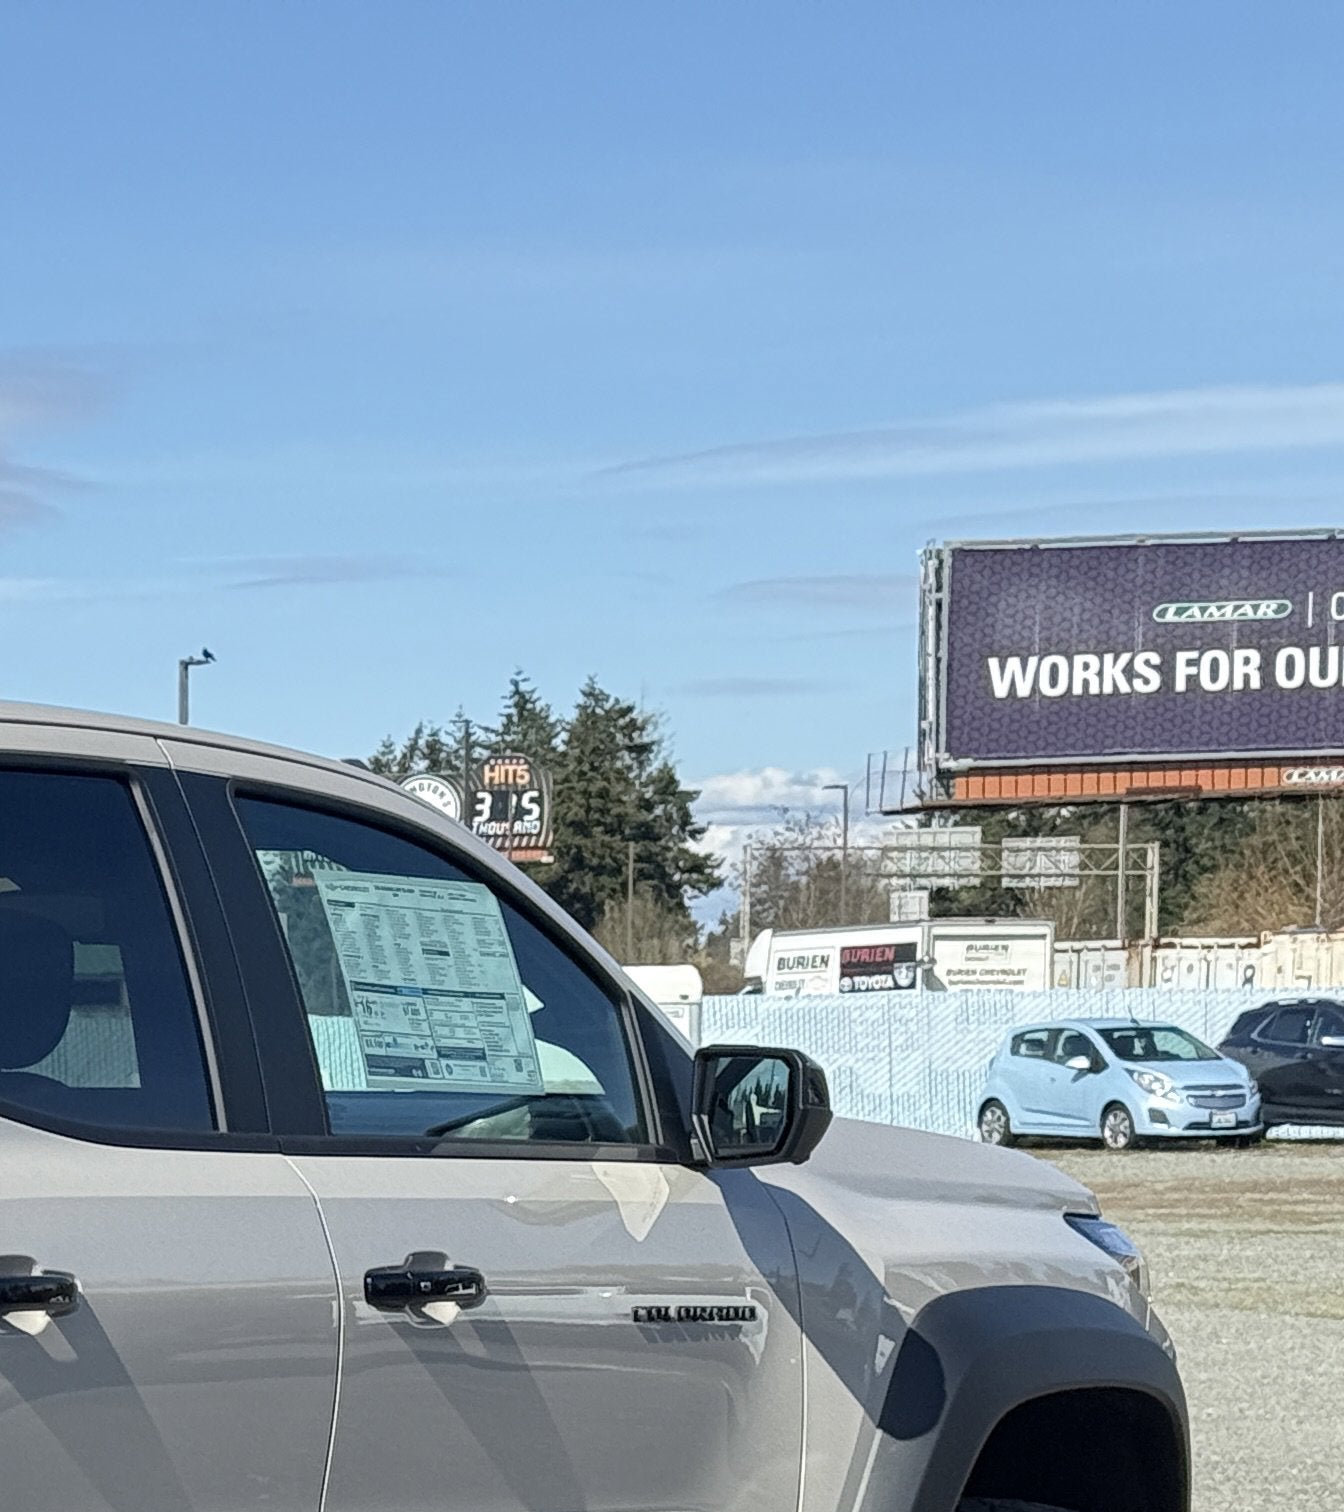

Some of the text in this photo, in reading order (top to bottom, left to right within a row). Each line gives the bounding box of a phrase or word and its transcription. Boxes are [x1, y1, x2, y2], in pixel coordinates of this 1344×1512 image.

[1163, 601, 1281, 619] LAMAR
[987, 645, 1344, 699] WORKS FOR OU
[777, 955, 831, 971] BURIEN
[842, 947, 896, 963] BURIEN
[854, 975, 895, 990] TOYOTA
